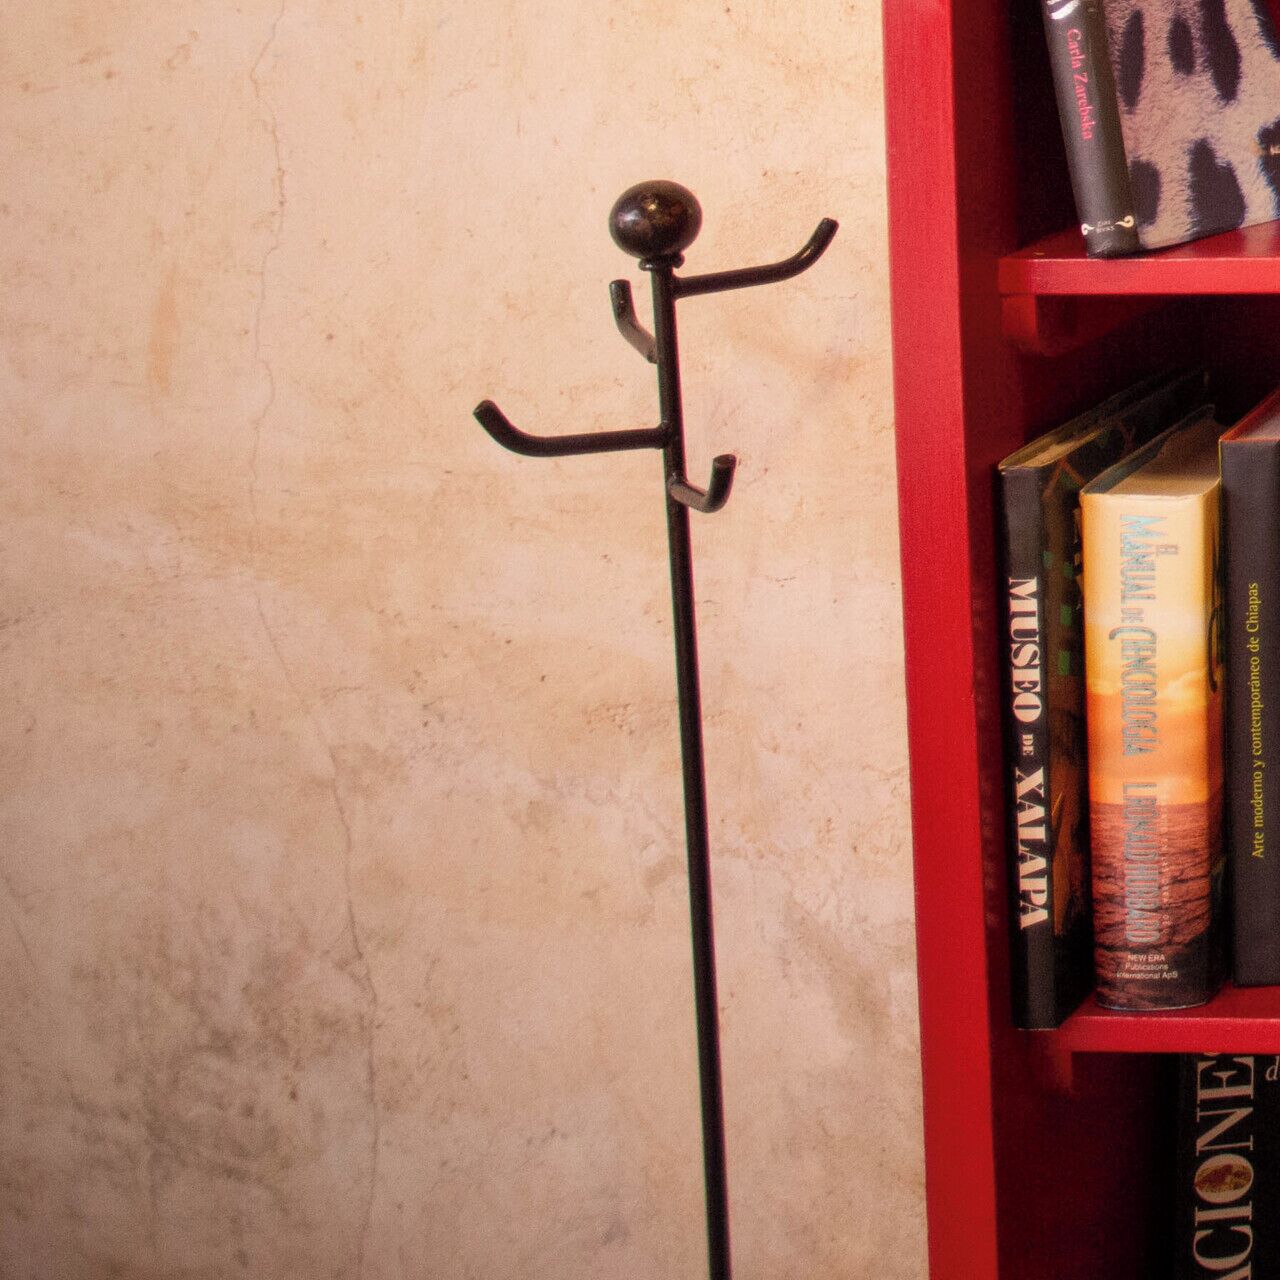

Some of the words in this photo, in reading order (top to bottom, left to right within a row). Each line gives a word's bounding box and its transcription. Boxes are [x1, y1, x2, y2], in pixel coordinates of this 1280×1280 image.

[1066, 28, 1087, 70] Carla
[1072, 71, 1097, 141] Zarebska
[1245, 581, 1262, 634] Chiapas
[1008, 576, 1043, 724] MUSEO
[1247, 636, 1260, 653] de
[1247, 655, 1265, 756] contemporáneo
[1022, 732, 1035, 757] DE
[1252, 757, 1266, 771] y
[1250, 771, 1265, 828] moderno
[1014, 765, 1050, 931] XALAPA
[1251, 832, 1265, 859] Arte
[1116, 970, 1161, 980] International
[1125, 961, 1169, 971] Publications
[1127, 954, 1146, 962] NEW
[1148, 954, 1166, 962] ERA
